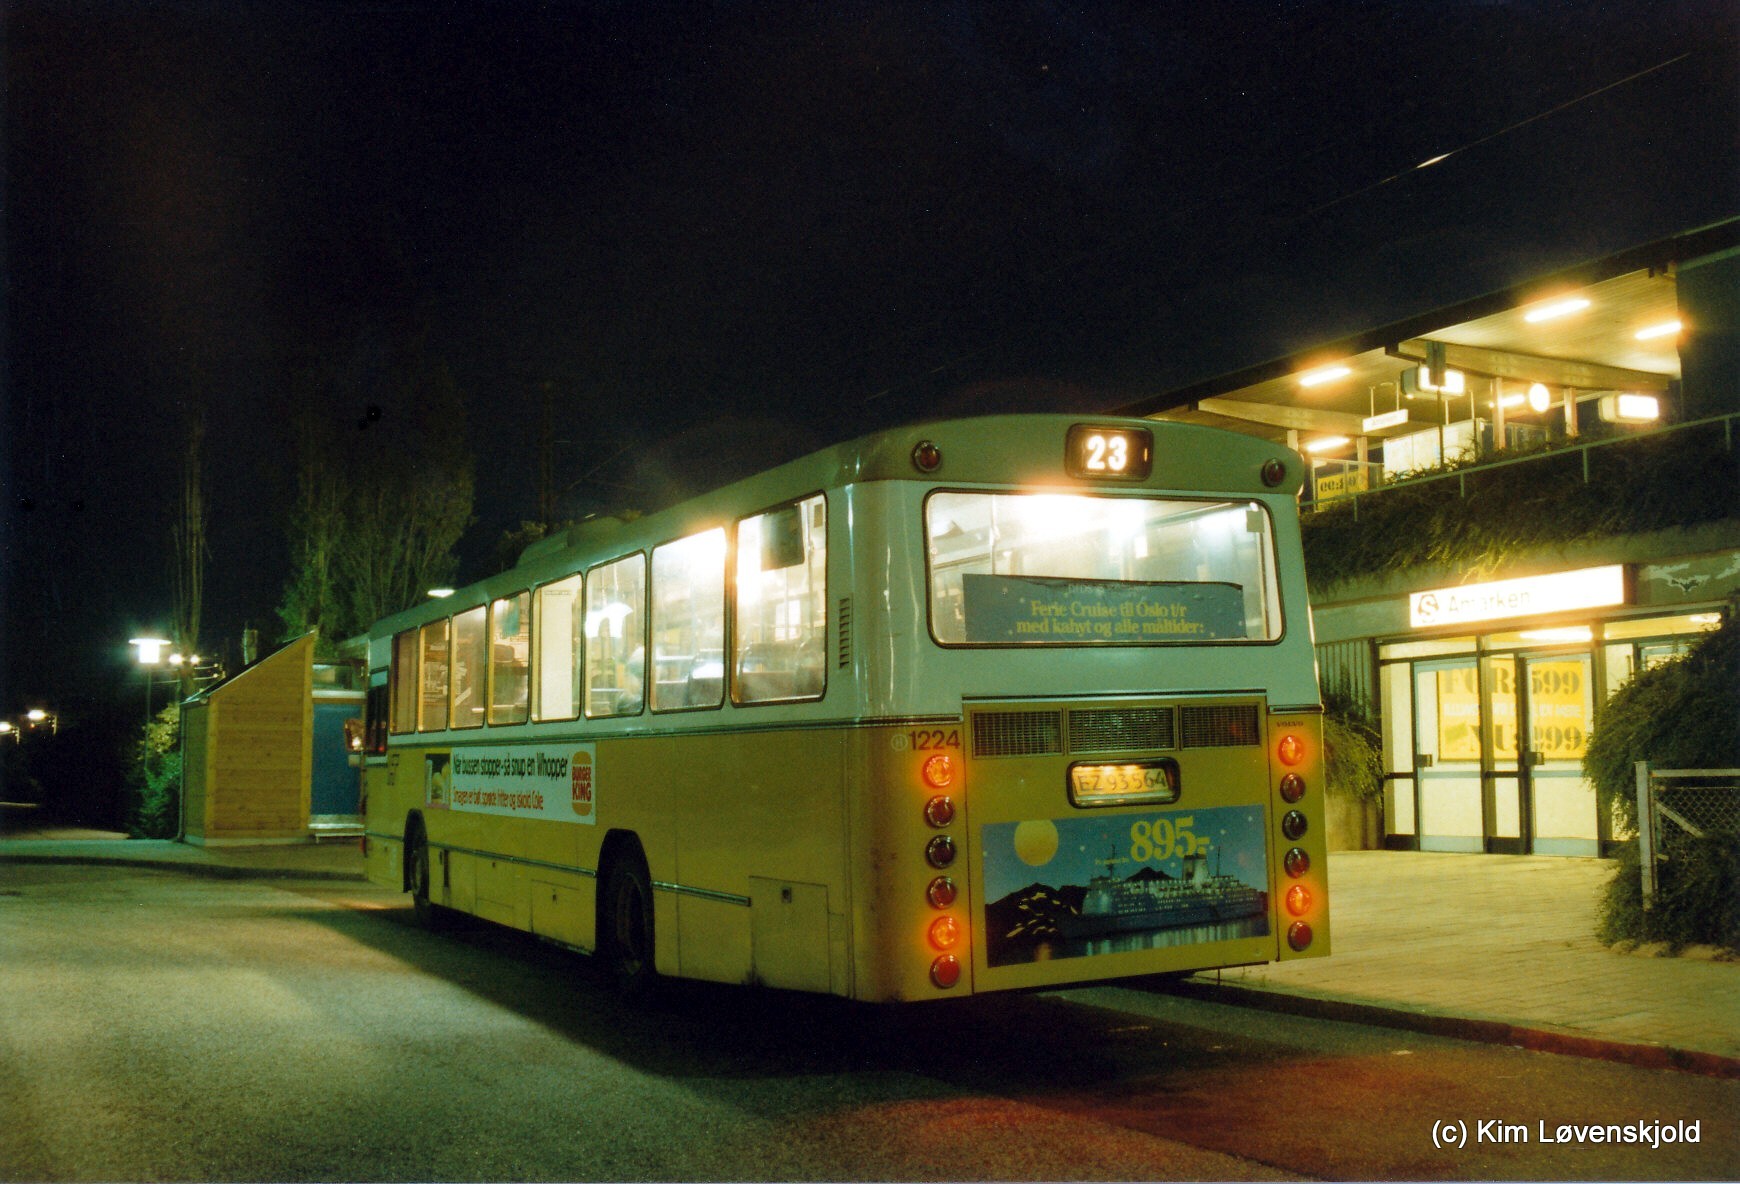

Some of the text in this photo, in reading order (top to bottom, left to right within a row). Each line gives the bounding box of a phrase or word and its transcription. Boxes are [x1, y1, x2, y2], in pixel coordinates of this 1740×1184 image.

[1087, 434, 1128, 471] 23
[1031, 601, 1187, 618] Ferie Cruise til Oslo t/r
[1016, 619, 1049, 633] med
[1053, 619, 1092, 637] kahyt
[1094, 622, 1112, 637] og
[1115, 619, 1139, 633] alle
[1276, 720, 1304, 728] VOLVO
[909, 729, 961, 750] 1224
[572, 765, 592, 782] BURGER
[1078, 774, 1103, 791] EZ
[572, 781, 592, 802] KING
